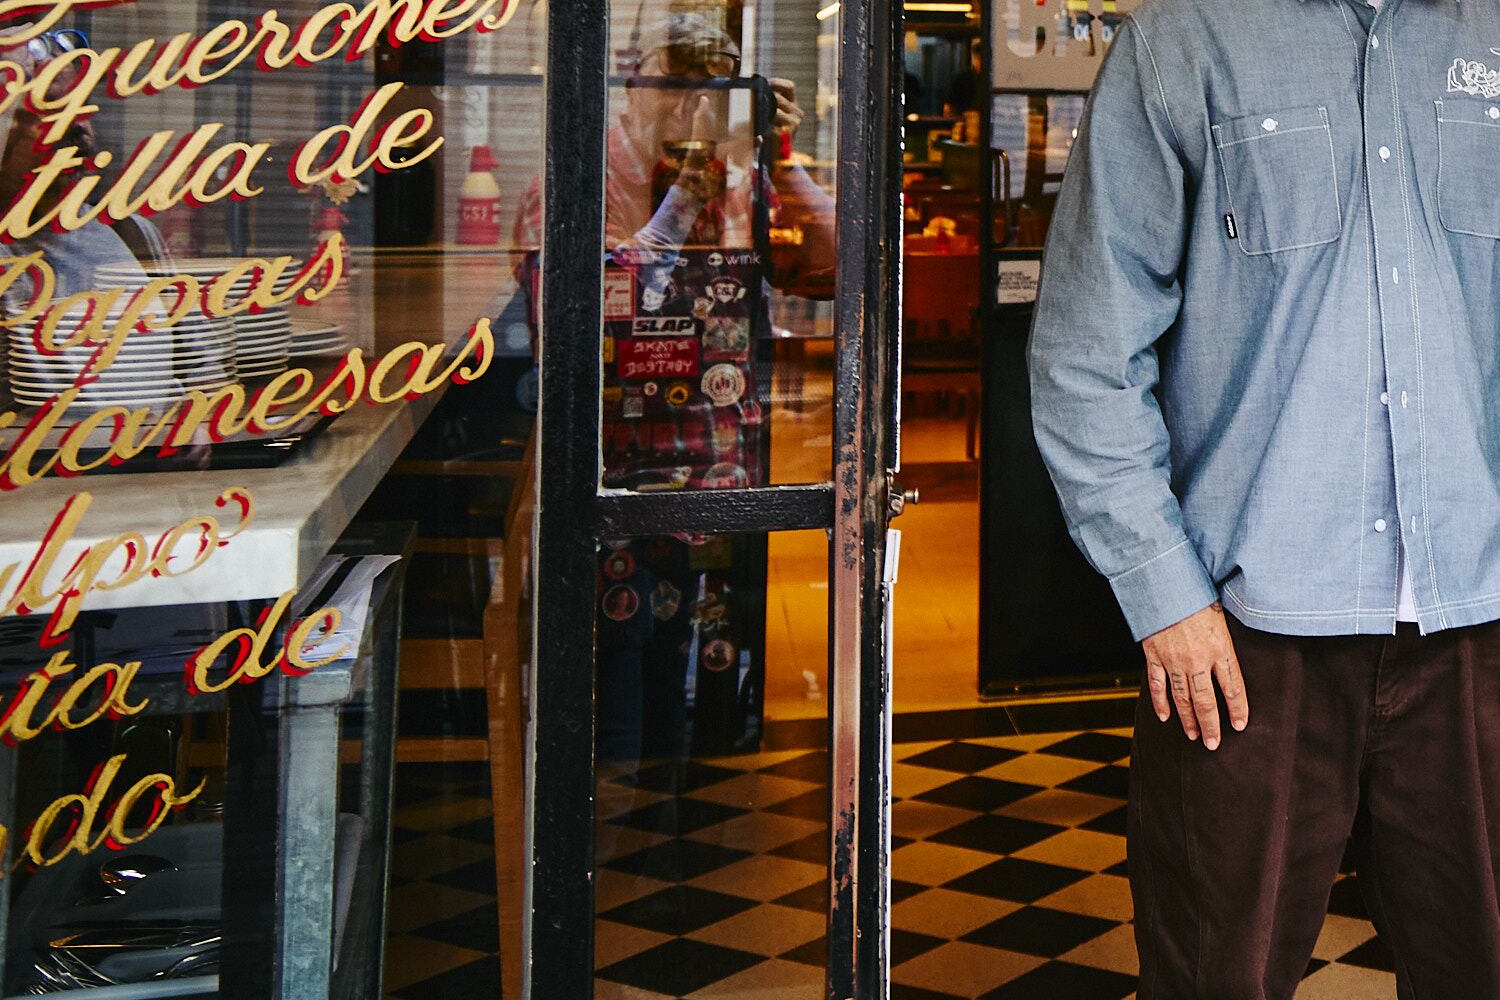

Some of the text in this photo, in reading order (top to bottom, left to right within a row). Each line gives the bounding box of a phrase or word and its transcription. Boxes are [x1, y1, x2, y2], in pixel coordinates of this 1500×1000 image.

[294, 81, 446, 187] de
[634, 318, 693, 333] SLAP
[194, 588, 353, 696] de
